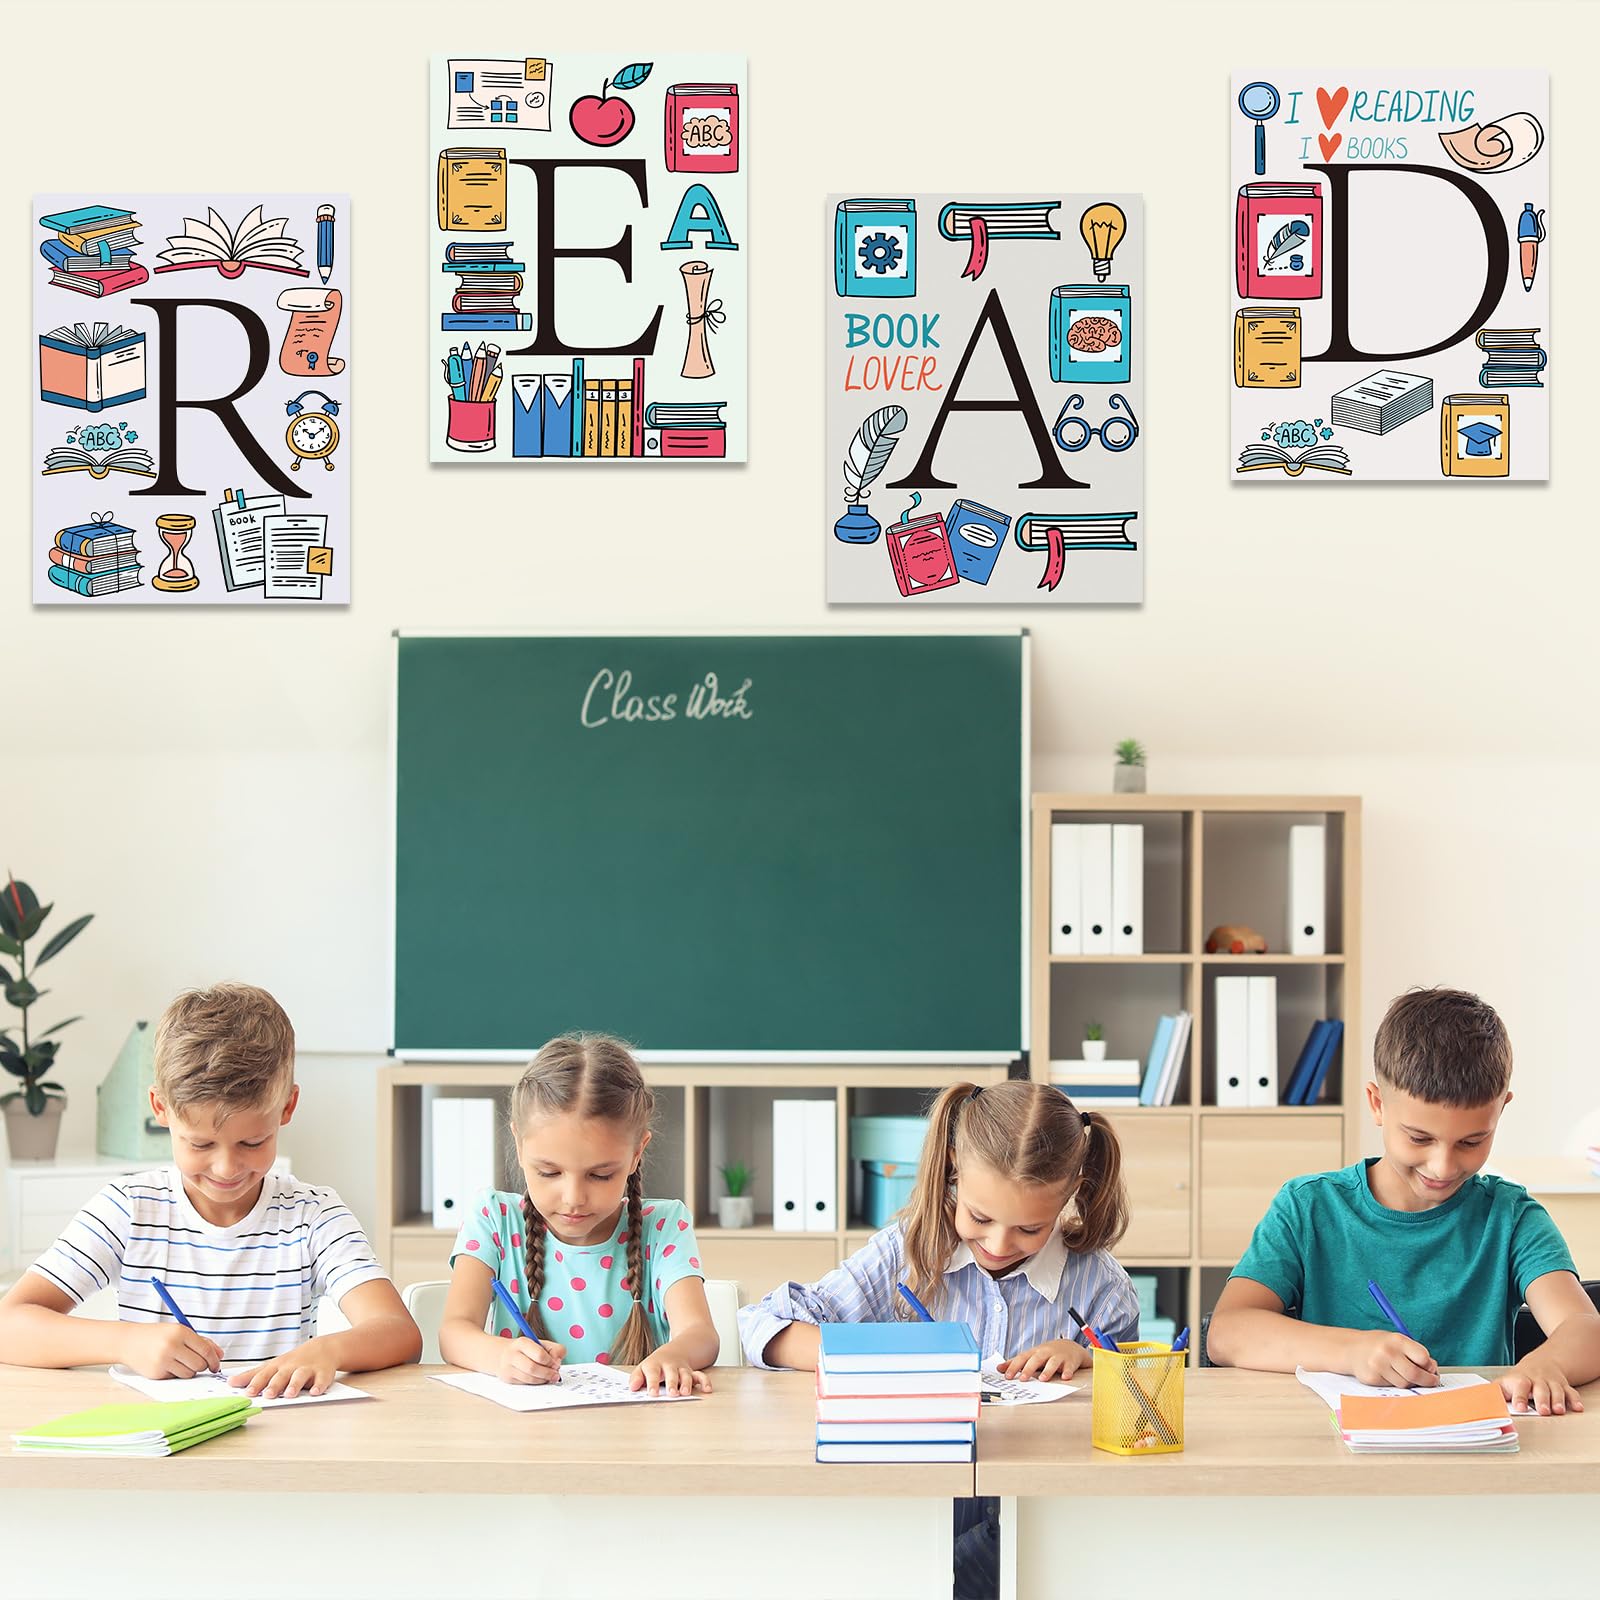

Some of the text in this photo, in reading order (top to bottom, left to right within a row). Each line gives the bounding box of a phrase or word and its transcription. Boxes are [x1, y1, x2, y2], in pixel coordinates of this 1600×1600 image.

[1284, 89, 1475, 125] I READING
[689, 124, 725, 142] ABC
[1298, 136, 1410, 160] I BOOKS
[660, 183, 740, 251] A
[506, 158, 665, 356] E
[1300, 163, 1510, 363] D
[844, 313, 941, 349] BOOK
[844, 355, 943, 392] LOVER
[885, 287, 1091, 489] A
[129, 298, 313, 499] R
[86, 431, 115, 447] ABC
[1280, 427, 1311, 444] ABC
[229, 513, 257, 526] BOOK
[580, 667, 753, 728] Class Work
